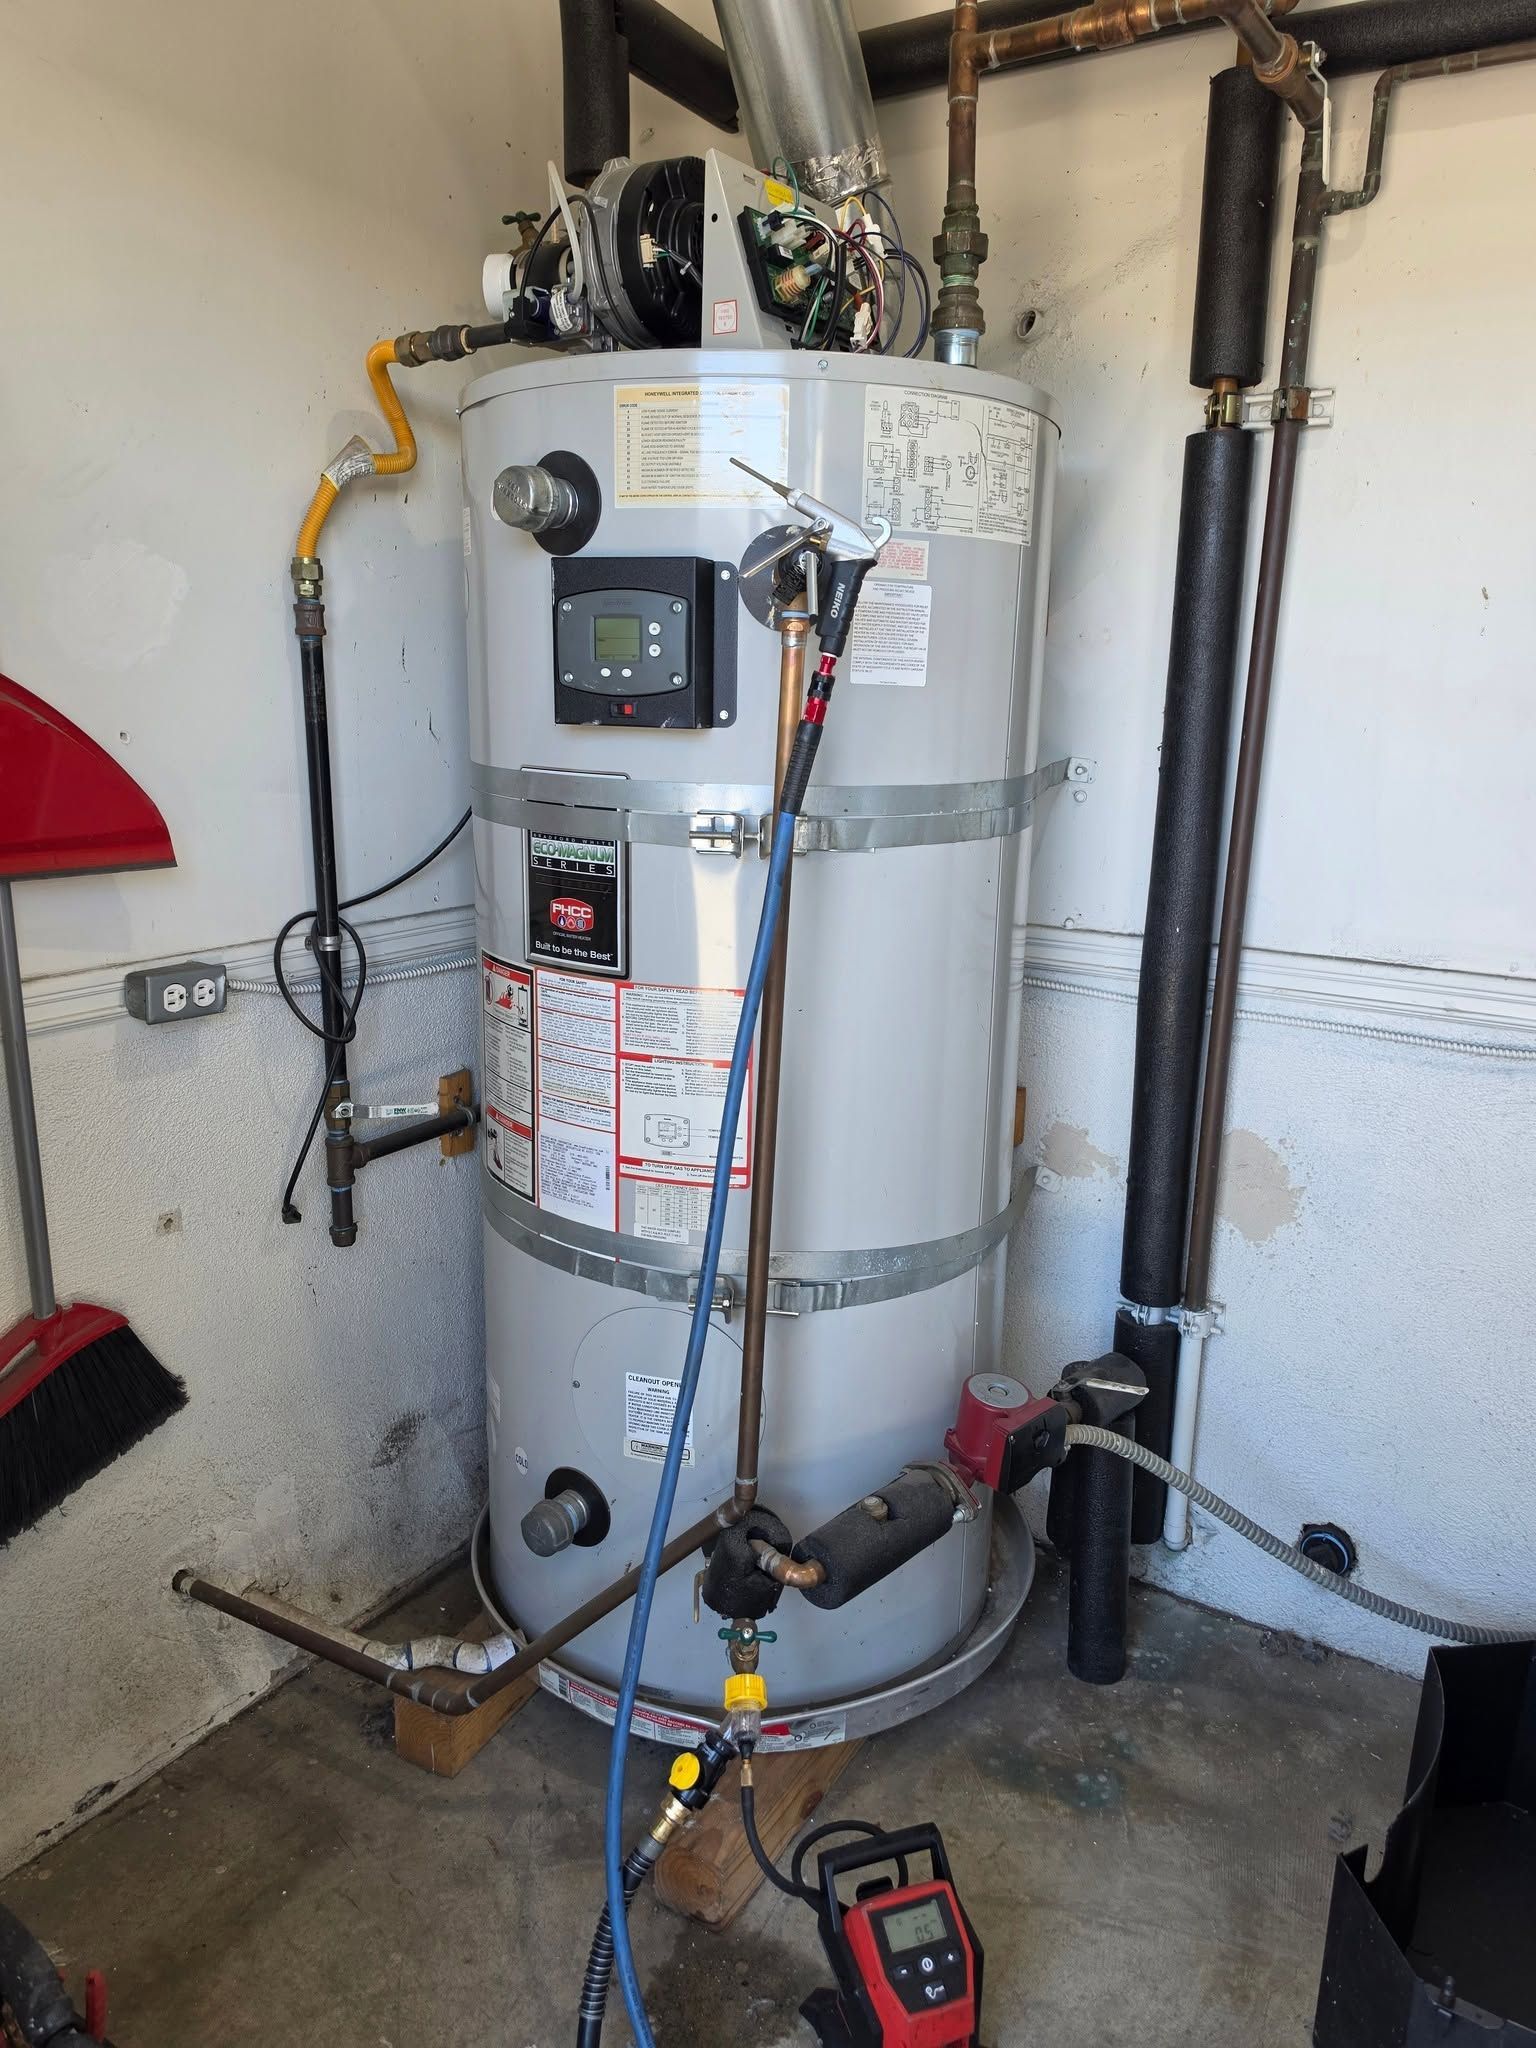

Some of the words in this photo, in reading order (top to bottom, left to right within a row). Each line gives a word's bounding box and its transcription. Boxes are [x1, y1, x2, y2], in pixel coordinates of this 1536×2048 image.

[831, 582, 846, 618] NEIKO
[533, 856, 613, 874] SERIES
[553, 903, 591, 918] PHCC
[535, 940, 550, 951] Built
[552, 944, 560, 953] to
[562, 946, 572, 955] be
[574, 948, 588, 957] the
[495, 966, 511, 977] DANGER
[628, 1375, 659, 1385] CLEANOUT
[516, 1454, 528, 1469] COLD
